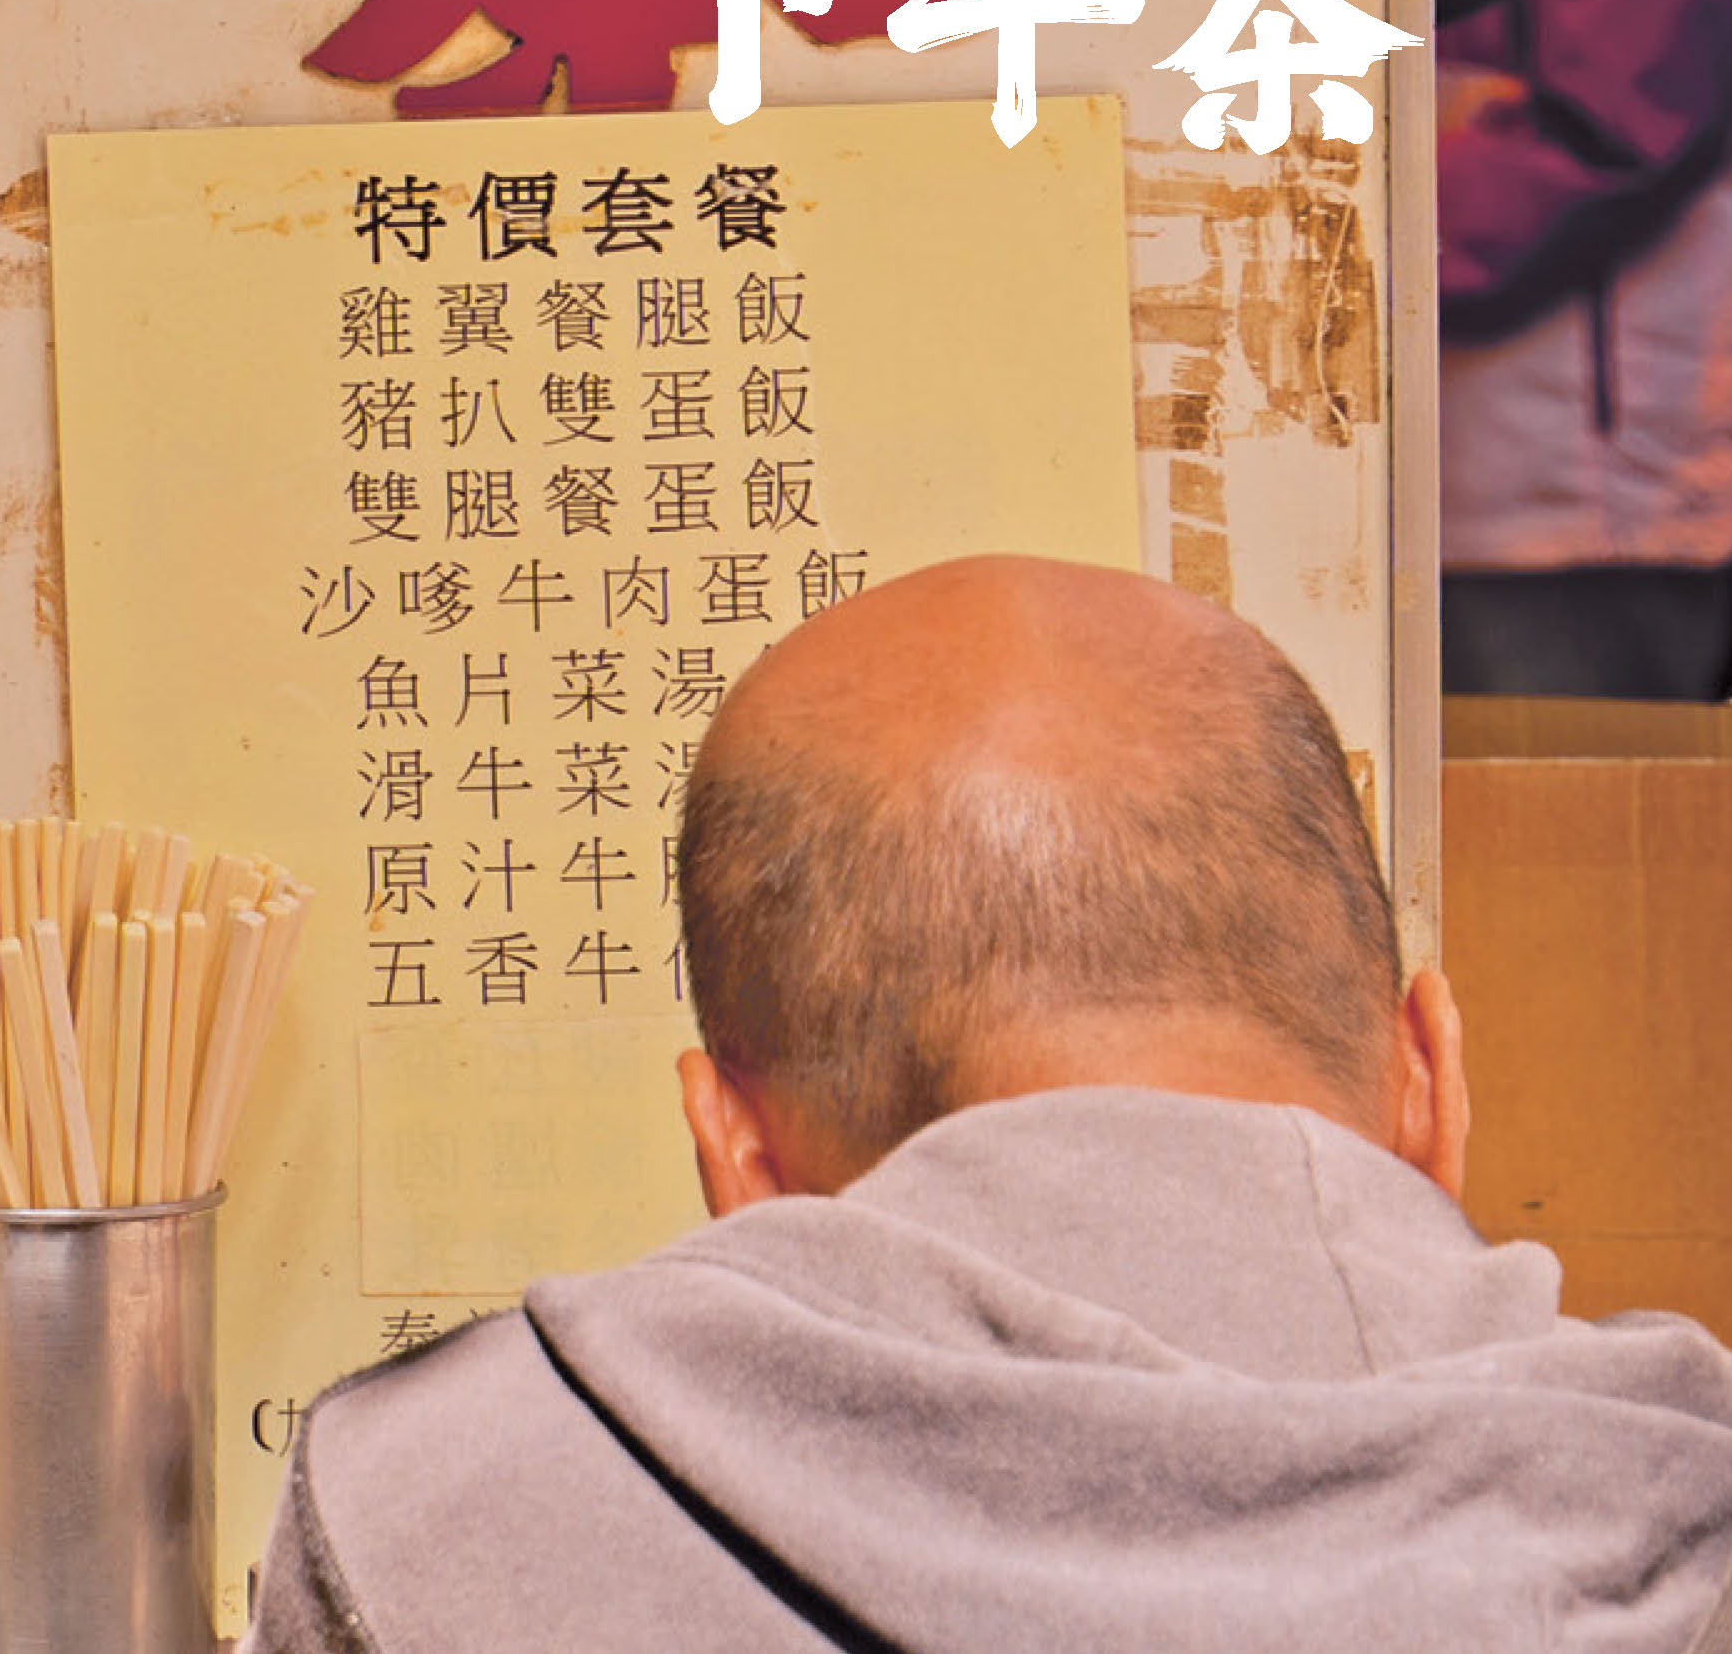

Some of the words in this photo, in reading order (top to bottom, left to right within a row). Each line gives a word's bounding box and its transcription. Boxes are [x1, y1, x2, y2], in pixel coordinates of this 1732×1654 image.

[353, 162, 789, 265] 特價套餐
[337, 270, 812, 360] 雞翼餐腿飯
[339, 363, 816, 452] 豬扒雙蛋飯
[343, 457, 822, 546] 雙腿餐蛋飯
[299, 548, 870, 639] 沙嗲牛肉蛋飯
[356, 644, 773, 730] 魚片菜湯
[363, 834, 681, 917] 原汁牛
[366, 929, 683, 1009] 五香牛
